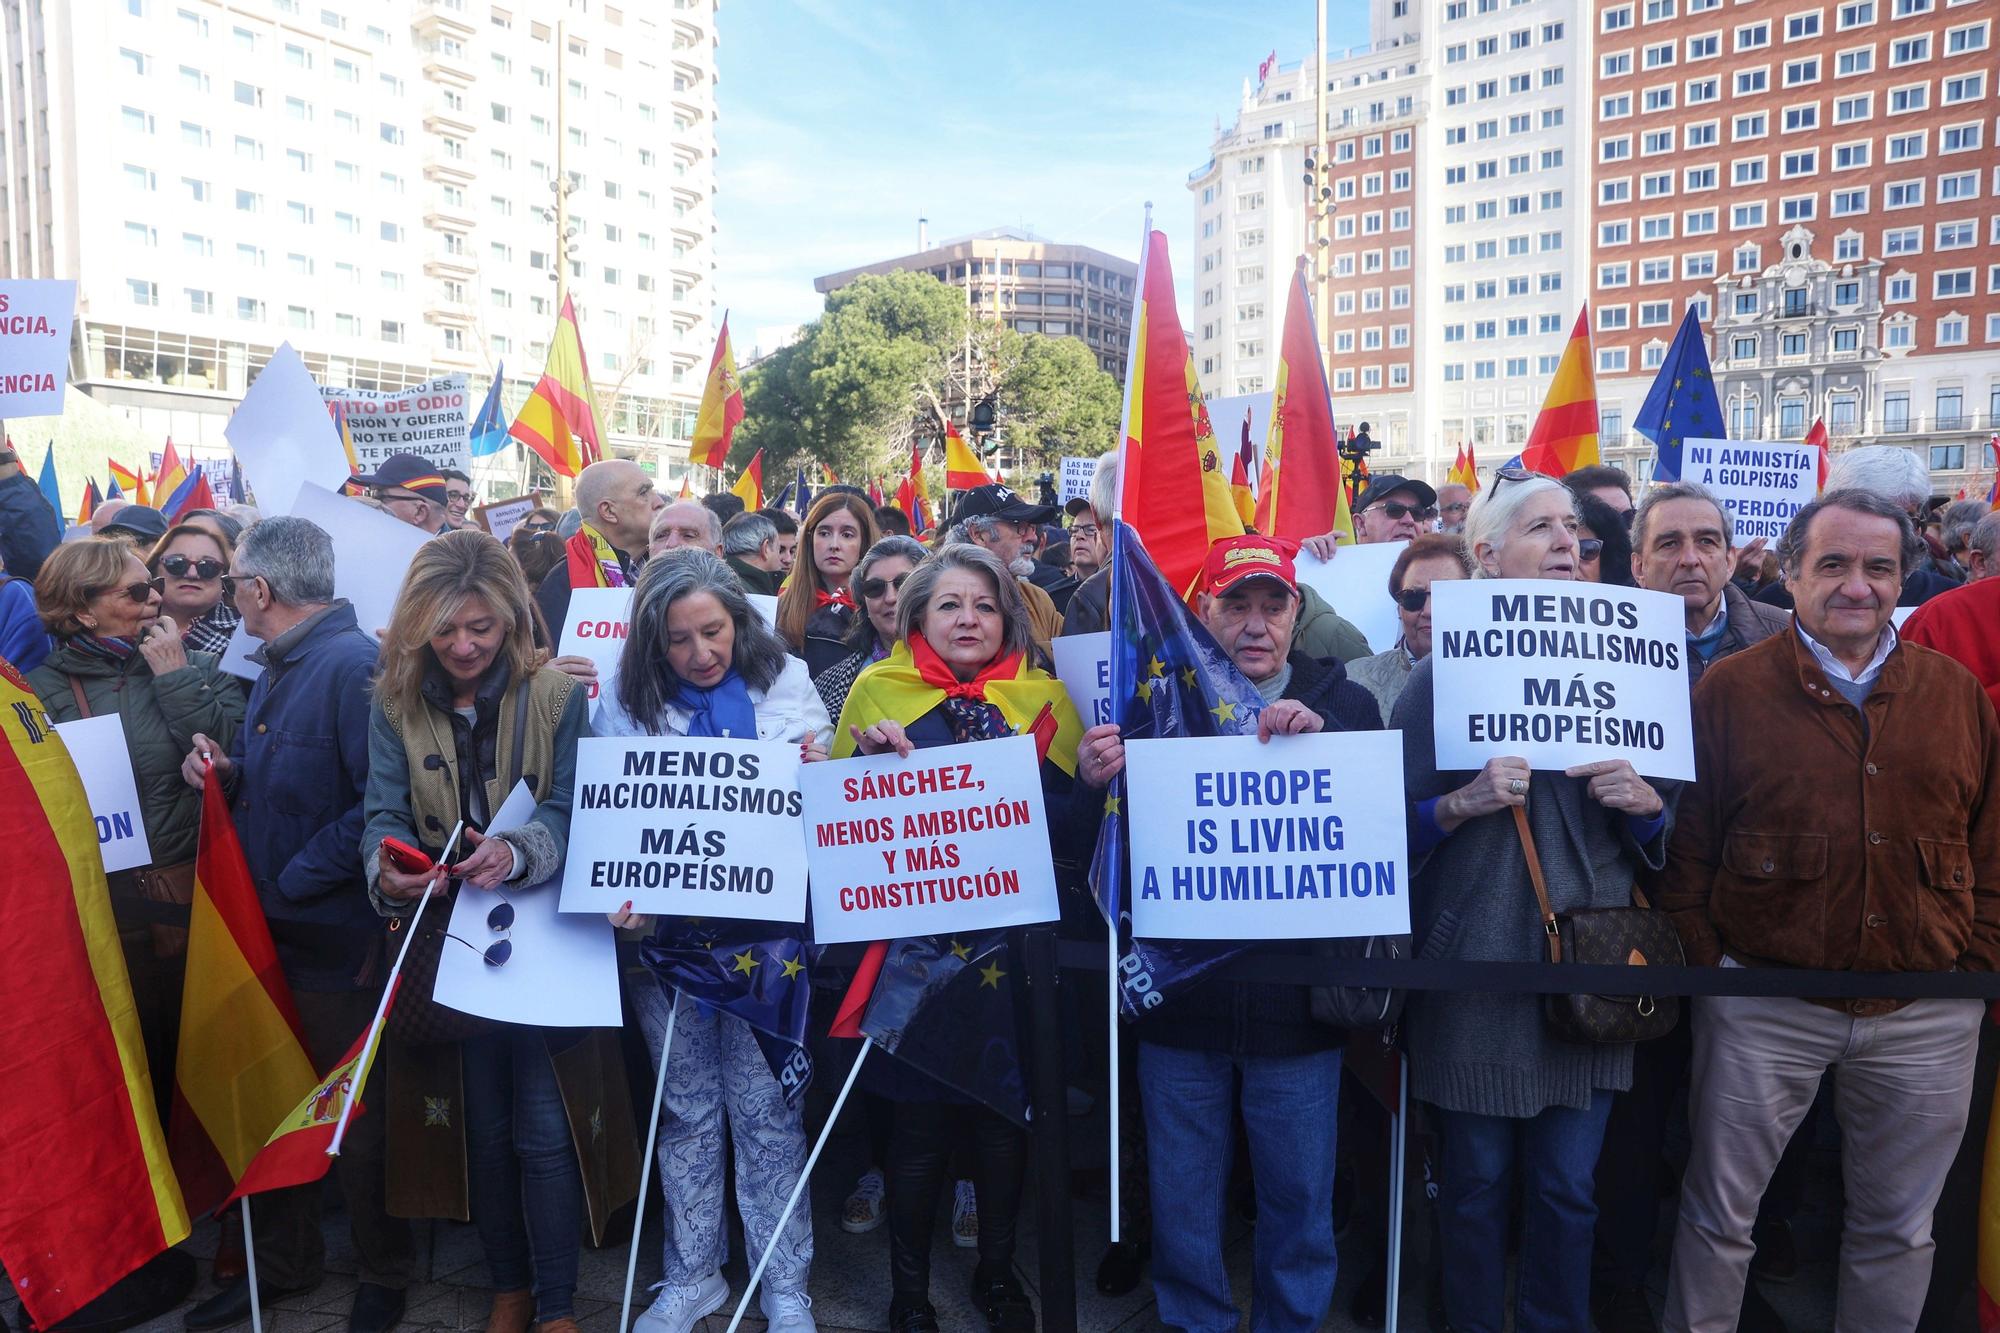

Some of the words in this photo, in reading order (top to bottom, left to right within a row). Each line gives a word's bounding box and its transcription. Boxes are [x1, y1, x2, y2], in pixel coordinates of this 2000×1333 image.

[384, 400, 410, 414] DE
[417, 394, 463, 410] ODIO
[392, 418, 401, 428] Y
[407, 412, 464, 426] GUERRA
[353, 433, 374, 444] NO
[378, 433, 398, 442] TE
[402, 426, 465, 442] QUIERE!!!
[360, 448, 378, 458] TE
[1691, 448, 1712, 464] NI
[1720, 450, 1811, 470] AMNISTÍA
[1702, 468, 1713, 484] A
[1720, 469, 1799, 489] GOLPISTAS
[1492, 594, 1638, 630] MENOS
[1442, 628, 1680, 670] NACIONALISMOS
[1524, 673, 1616, 710] MÁS
[1468, 710, 1664, 750] EUROPEÍSMO
[623, 752, 760, 780] MENOS
[844, 764, 985, 802] SÁNCHEZ,
[580, 783, 802, 818] NACIONALISMOS
[1195, 768, 1332, 807] EUROPE
[640, 823, 726, 858] MÁS
[816, 816, 894, 847] MENOS
[903, 798, 1030, 840] AMBICIÓN
[1187, 819, 1218, 854] IS
[1231, 815, 1344, 854] LIVING
[882, 850, 896, 874] Y
[905, 840, 960, 872] MÁS
[590, 858, 774, 894] EUROPEÍSMO
[840, 867, 1020, 912] CONSTITUCIÓN
[1141, 866, 1161, 900] A
[1172, 860, 1396, 901] HUMILIATION
